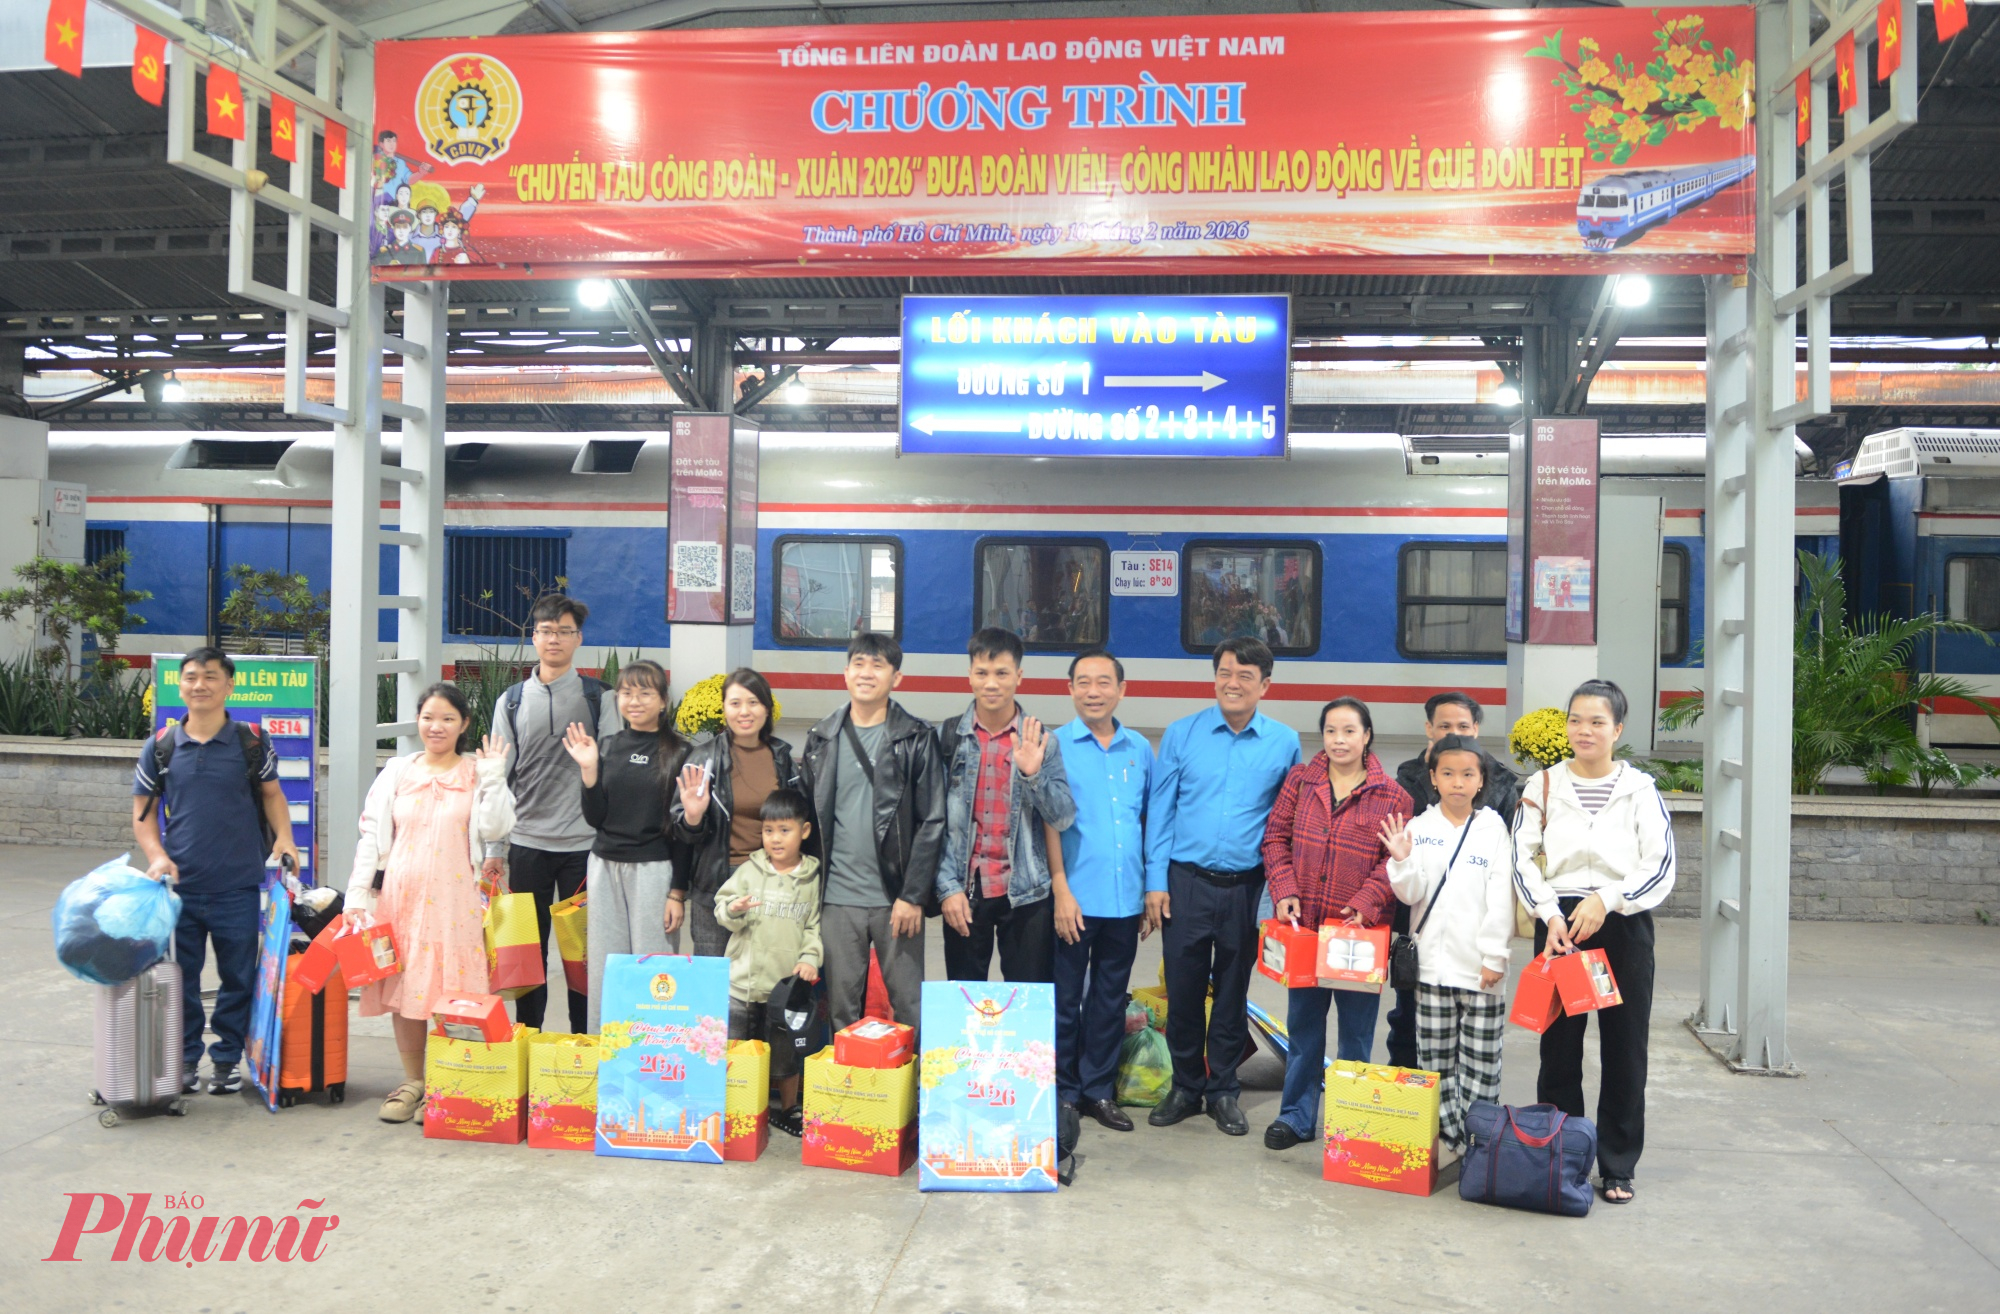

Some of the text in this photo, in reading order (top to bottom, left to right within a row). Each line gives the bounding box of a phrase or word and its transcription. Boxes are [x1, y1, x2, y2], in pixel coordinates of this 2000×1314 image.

[778, 34, 1285, 67] TỔNG LIÊN ĐOÀN LAO ĐỘNG VIỆT NAM
[810, 70, 1246, 134] CHƯƠNG TRÌNH
[601, 156, 645, 200] TÀU
[650, 154, 708, 200] CÔNG
[712, 152, 776, 199] ĐOÀN
[795, 151, 859, 197] XUÂN
[927, 155, 977, 196] ĐƯA
[981, 148, 1047, 195] ĐOÀN
[1120, 145, 1183, 193] CÔNG
[1188, 144, 1251, 191] NHÂN
[1260, 149, 1311, 192] LAO
[1315, 142, 1383, 198] ĐỘNG
[1389, 134, 1422, 190] VỀ
[1427, 141, 1476, 190] QUÊ
[1481, 140, 1534, 188] ĐÓN
[1540, 133, 1585, 189] TẾT
[803, 225, 858, 244] Thành
[860, 222, 899, 247] phố
[899, 221, 926, 243] Hồ
[929, 224, 963, 243] Chí
[964, 222, 1017, 244] Minh,
[1020, 223, 1062, 246] ngày
[1143, 222, 1158, 241] 2
[1160, 221, 1201, 241] năm
[1204, 221, 1249, 240] 2026
[930, 309, 1257, 344] LỐI KHÁCH VÀO TÀU
[957, 362, 1029, 395] ĐƯỜNG
[1081, 361, 1090, 395] 1
[1028, 408, 1102, 440] ĐƯỜNG
[676, 457, 720, 467] Đặt vé tàu
[676, 469, 723, 477] trên MoMo
[1537, 466, 1587, 476] Đặt vé tàu
[1537, 477, 1591, 486] trên MoMo
[1121, 560, 1139, 571] Tàu
[1149, 559, 1173, 571] SE14
[1114, 575, 1172, 589] Chạy lúc: 8h30
[250, 669, 278, 687] LÊN
[281, 669, 308, 687] TÀU
[269, 719, 302, 734] SE14
[639, 1053, 687, 1082] 2026
